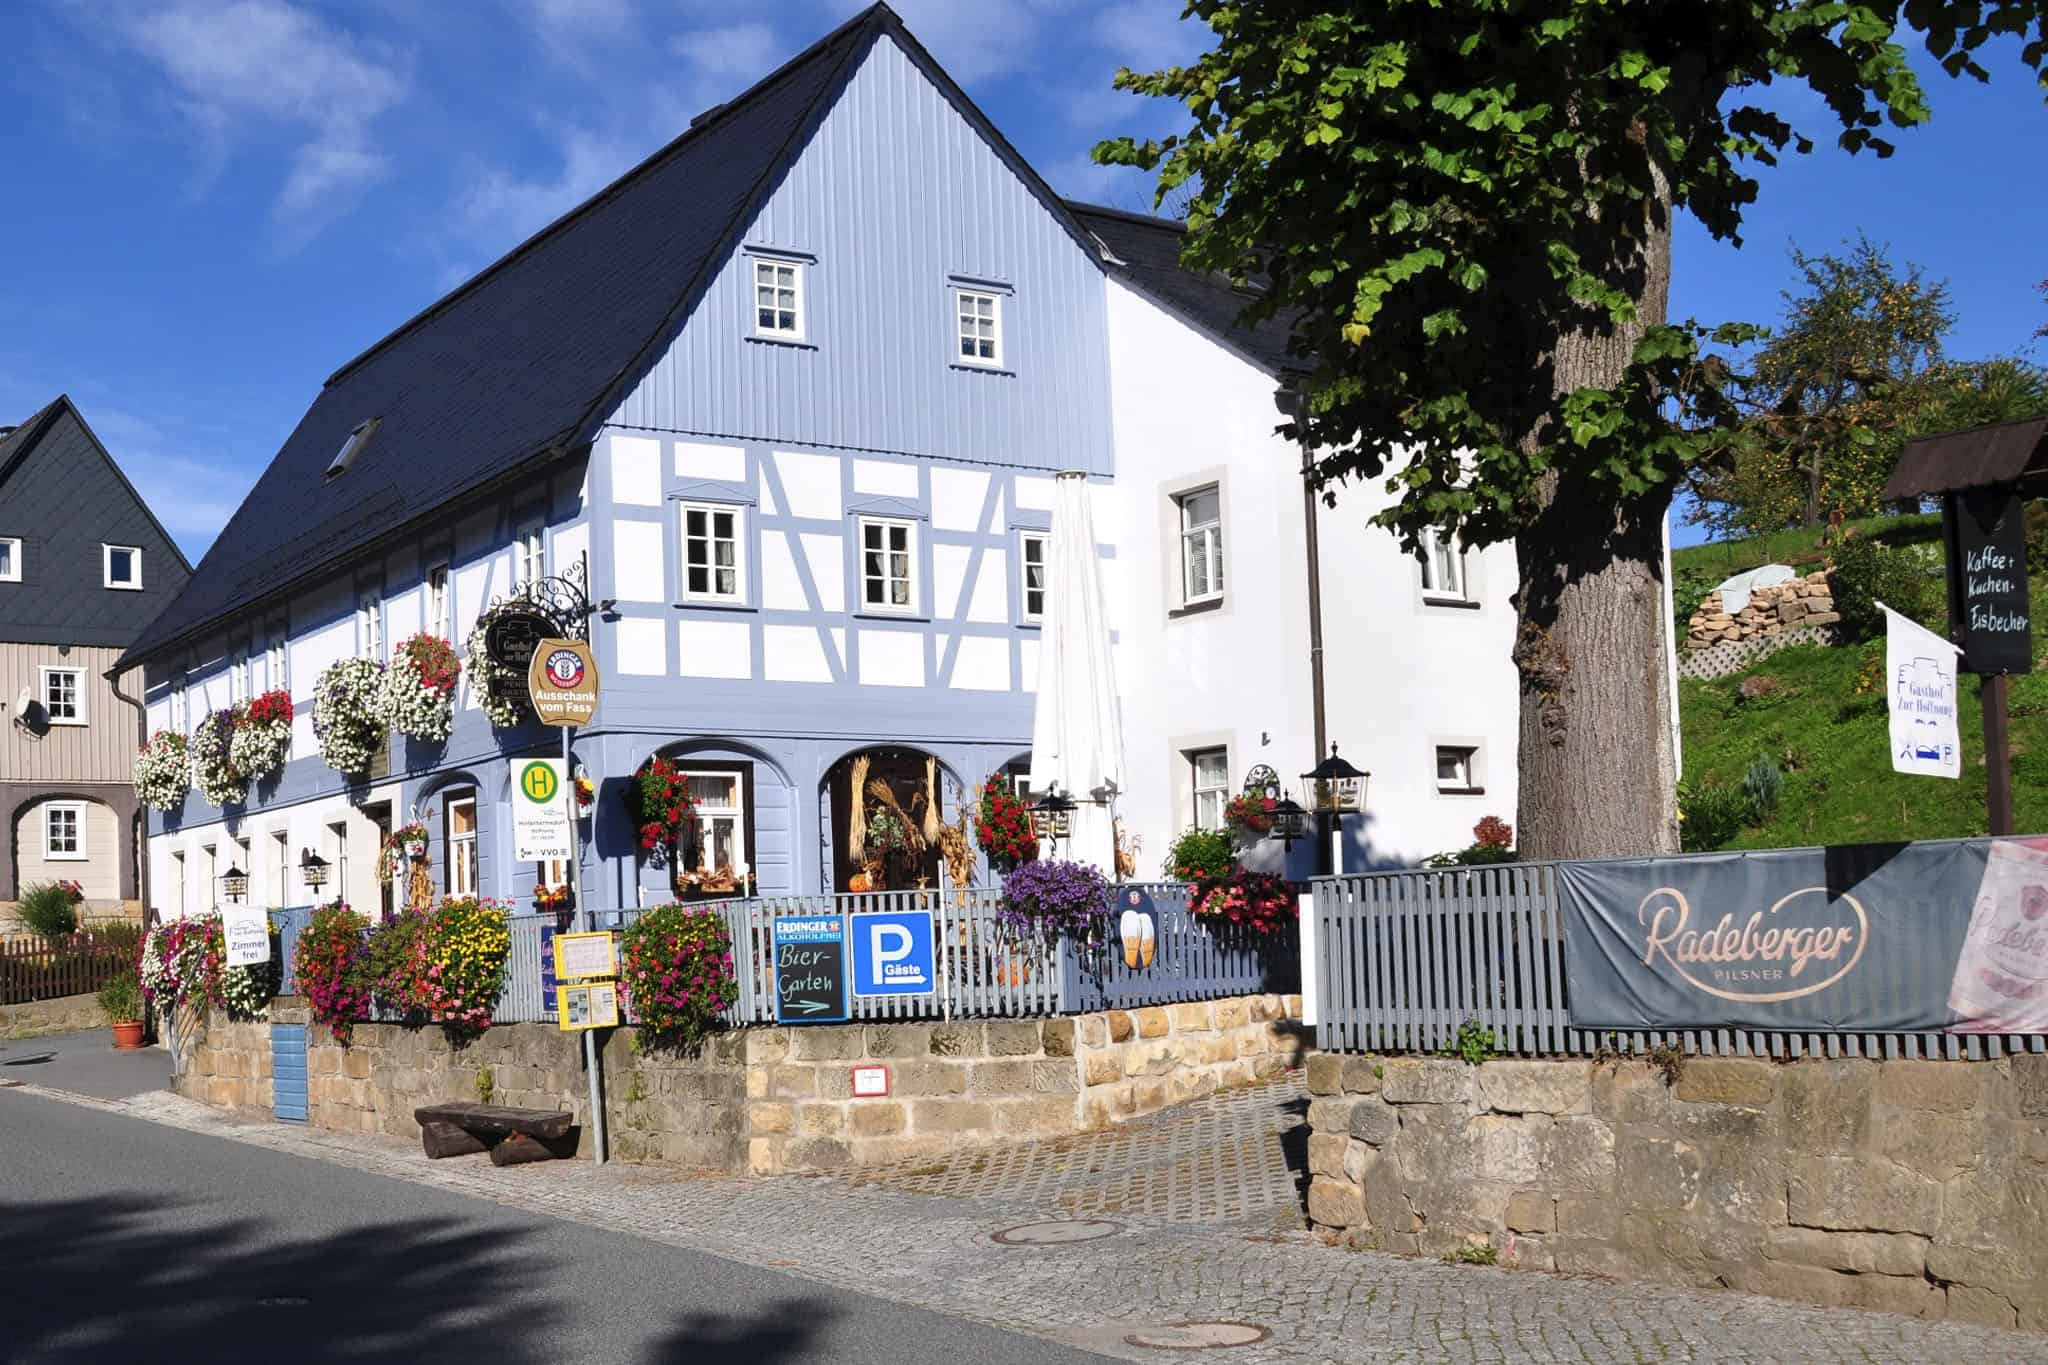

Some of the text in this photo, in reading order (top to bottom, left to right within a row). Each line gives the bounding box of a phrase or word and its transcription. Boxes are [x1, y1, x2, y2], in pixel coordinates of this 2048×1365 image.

[1967, 545, 2006, 572] Kaffee
[1970, 603, 2028, 632] Eisbecher
[536, 690, 596, 702] Ausschank
[1910, 681, 1944, 698] Gasthof
[540, 702, 592, 713] vom Fass
[1898, 697, 1912, 710] Zur
[532, 770, 547, 794] H
[777, 921, 828, 934] ERDINGER
[1638, 888, 1852, 977] Radeberger
[777, 932, 841, 941] ALKOHOLFREI
[231, 942, 265, 951] Zimmer
[242, 951, 258, 960] frei
[778, 943, 832, 968] Bier-
[871, 924, 912, 984] P
[884, 964, 921, 976] Gäste
[1714, 969, 1783, 981] PILSNER
[778, 972, 832, 1001] Garten
